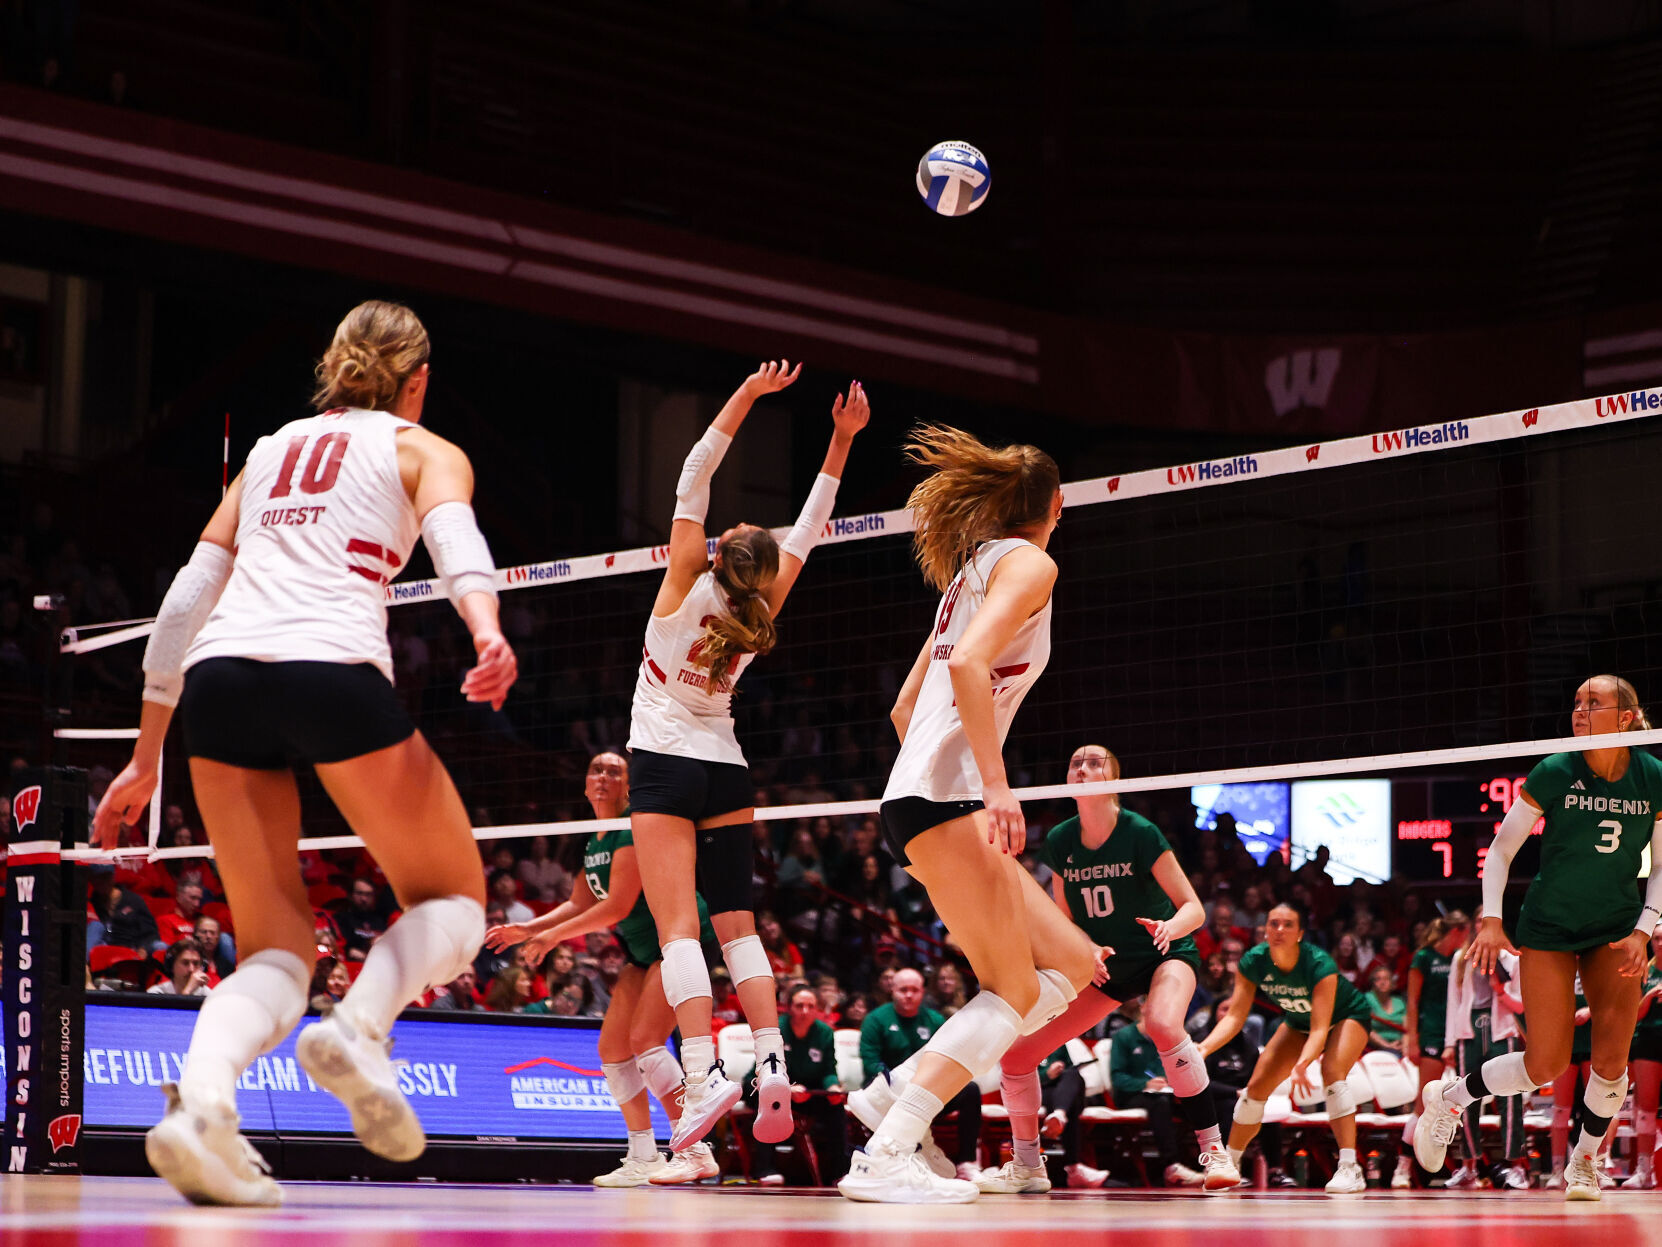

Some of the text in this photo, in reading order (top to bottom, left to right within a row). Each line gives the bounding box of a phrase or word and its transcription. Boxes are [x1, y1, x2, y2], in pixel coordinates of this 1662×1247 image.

[269, 432, 351, 500] 10
[261, 506, 326, 527] QUEST
[1564, 794, 1651, 815] PHOENIX
[1595, 819, 1623, 854] 3
[1432, 841, 1453, 878] 7
[1081, 885, 1115, 919] 10
[1278, 998, 1312, 1014] 20
[8, 875, 35, 1173] WISCONSIN
[59, 1009, 72, 1052] sports
[59, 1054, 71, 1107] imports
[511, 1076, 590, 1095] AMERICAN
[524, 1094, 617, 1108] INSURAN
